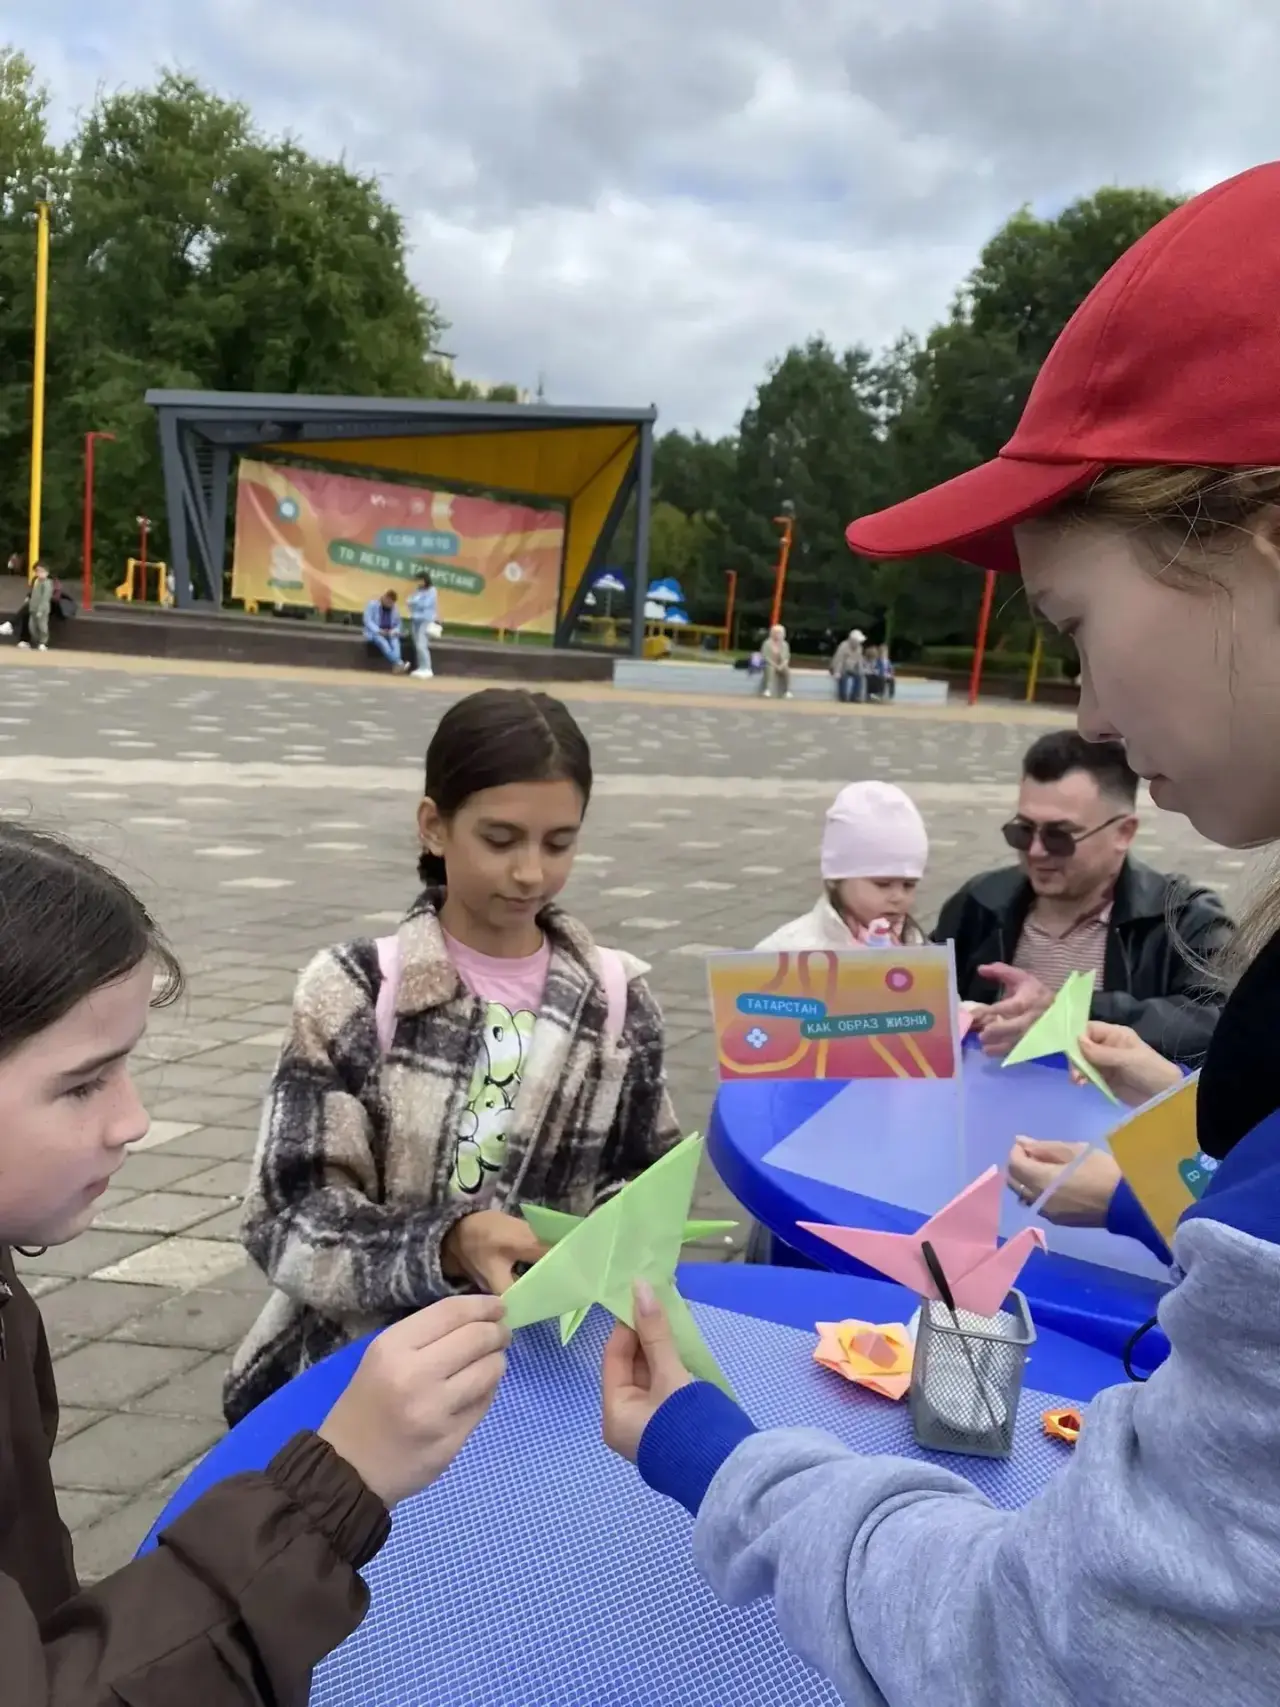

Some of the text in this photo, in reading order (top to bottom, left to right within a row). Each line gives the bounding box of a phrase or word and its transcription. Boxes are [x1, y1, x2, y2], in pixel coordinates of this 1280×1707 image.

[338, 546, 355, 560] ТО
[360, 553, 390, 571] ЛЕТО
[747, 998, 818, 1015] ТАТАРСТАН
[807, 1015, 928, 1034] КАК ОБРАЗ ЖИЗНИ
